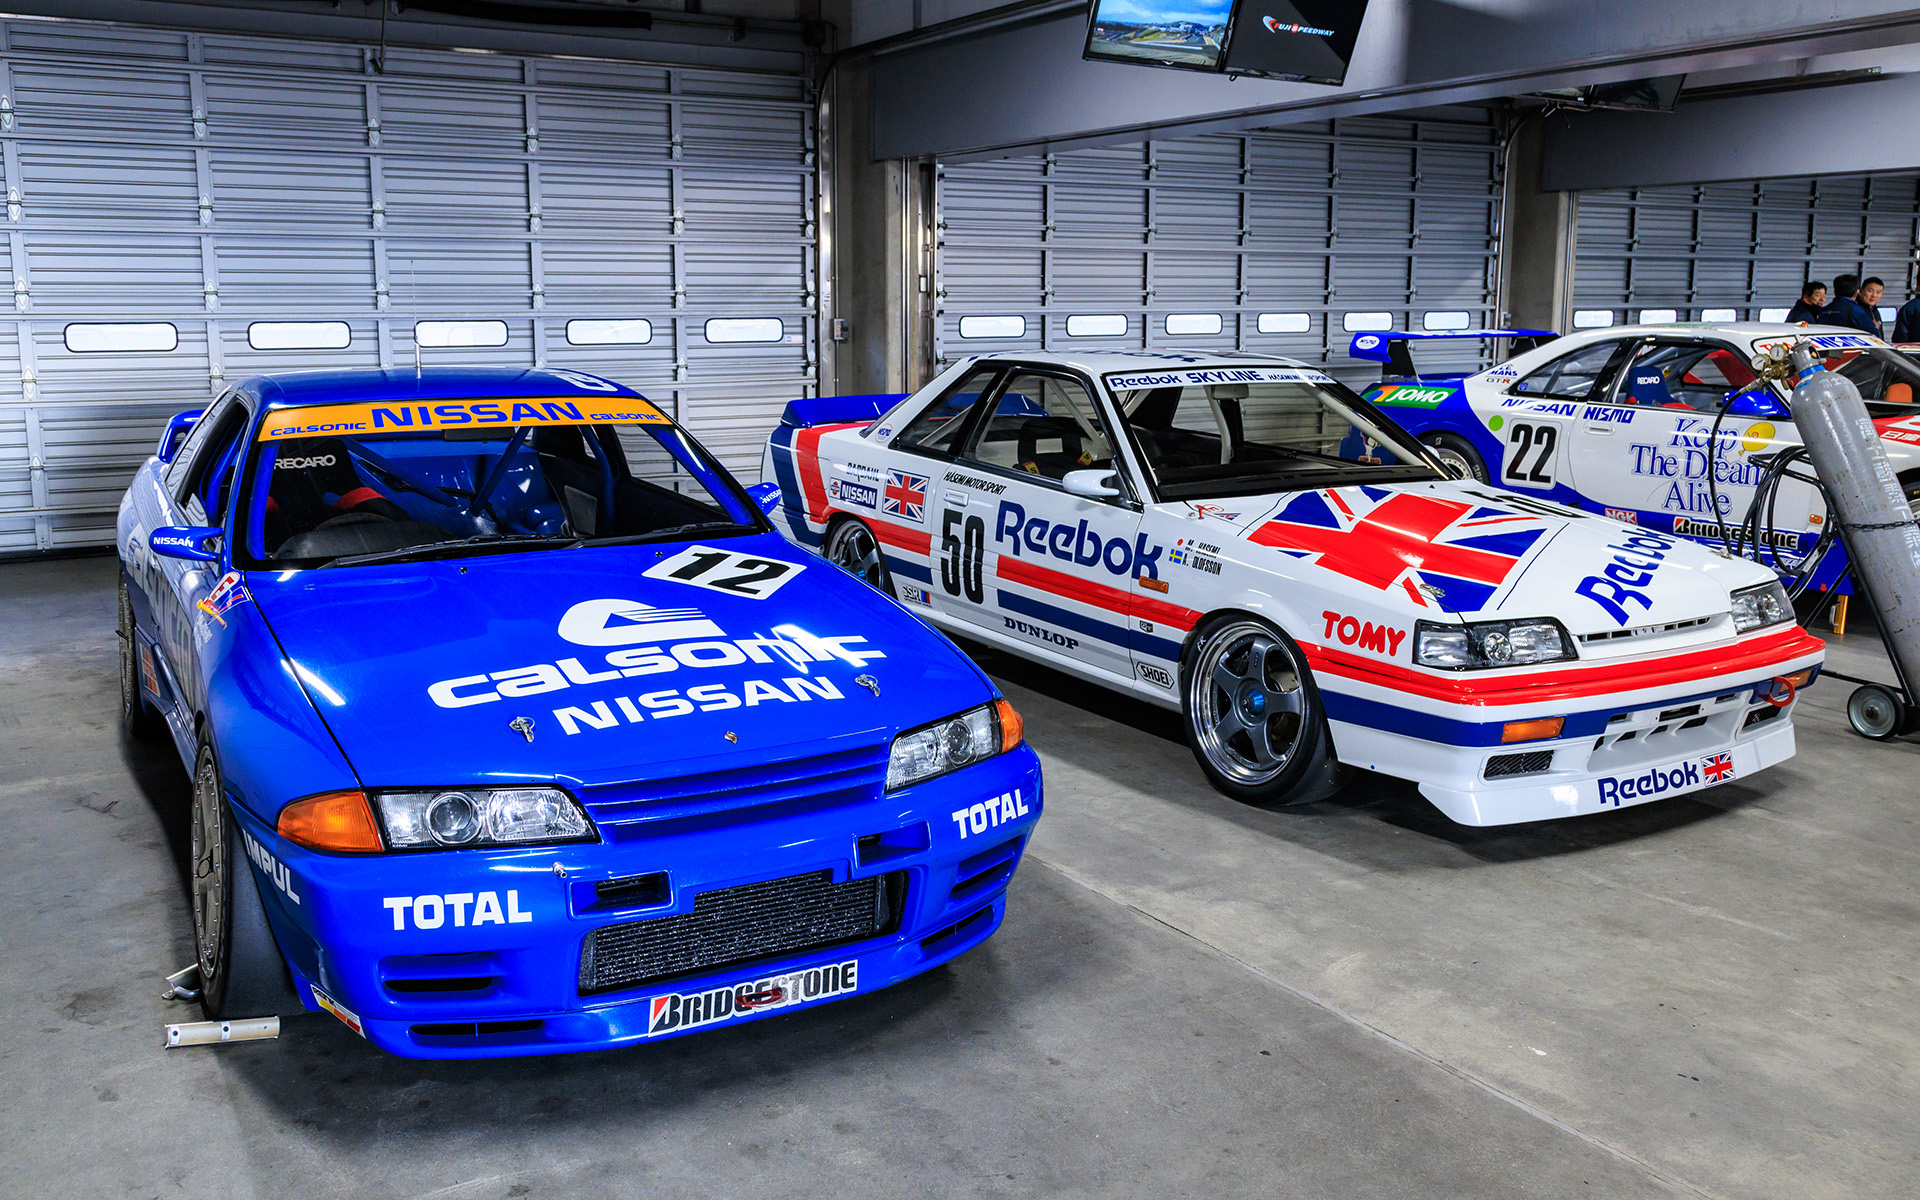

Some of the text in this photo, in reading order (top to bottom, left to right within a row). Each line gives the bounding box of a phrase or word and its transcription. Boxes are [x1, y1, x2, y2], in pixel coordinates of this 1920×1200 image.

[1291, 24, 1335, 37] SPEEDWAY
[1109, 374, 1181, 389] Reebok
[1186, 370, 1265, 383] SKYLINE
[1386, 389, 1449, 403] JOMO
[1637, 376, 1660, 385] RECARO
[371, 402, 585, 428] NISSAN
[1583, 406, 1636, 424] NISMO
[274, 454, 336, 469] RECARO
[1506, 423, 1557, 484] 22
[1631, 443, 1679, 477] The
[842, 485, 876, 505] NISSAN
[1663, 480, 1731, 515] Alive
[1607, 510, 1636, 524] NGK
[1675, 517, 1798, 549] BRIDGESONE
[153, 536, 194, 547] NISSAN
[941, 508, 984, 604] 50
[995, 499, 1163, 580] Reebok
[667, 551, 791, 595] 12
[1574, 527, 1680, 627] Reebok
[1003, 616, 1079, 649] DUNLOP
[1322, 610, 1406, 657] TOMY
[1142, 664, 1170, 687] SHOEI
[552, 676, 845, 735] NISSAN
[1598, 761, 1700, 806] Reebok
[952, 788, 1029, 839] TOTAL
[243, 828, 300, 905] IMPUL
[383, 890, 533, 931] TOTAL
